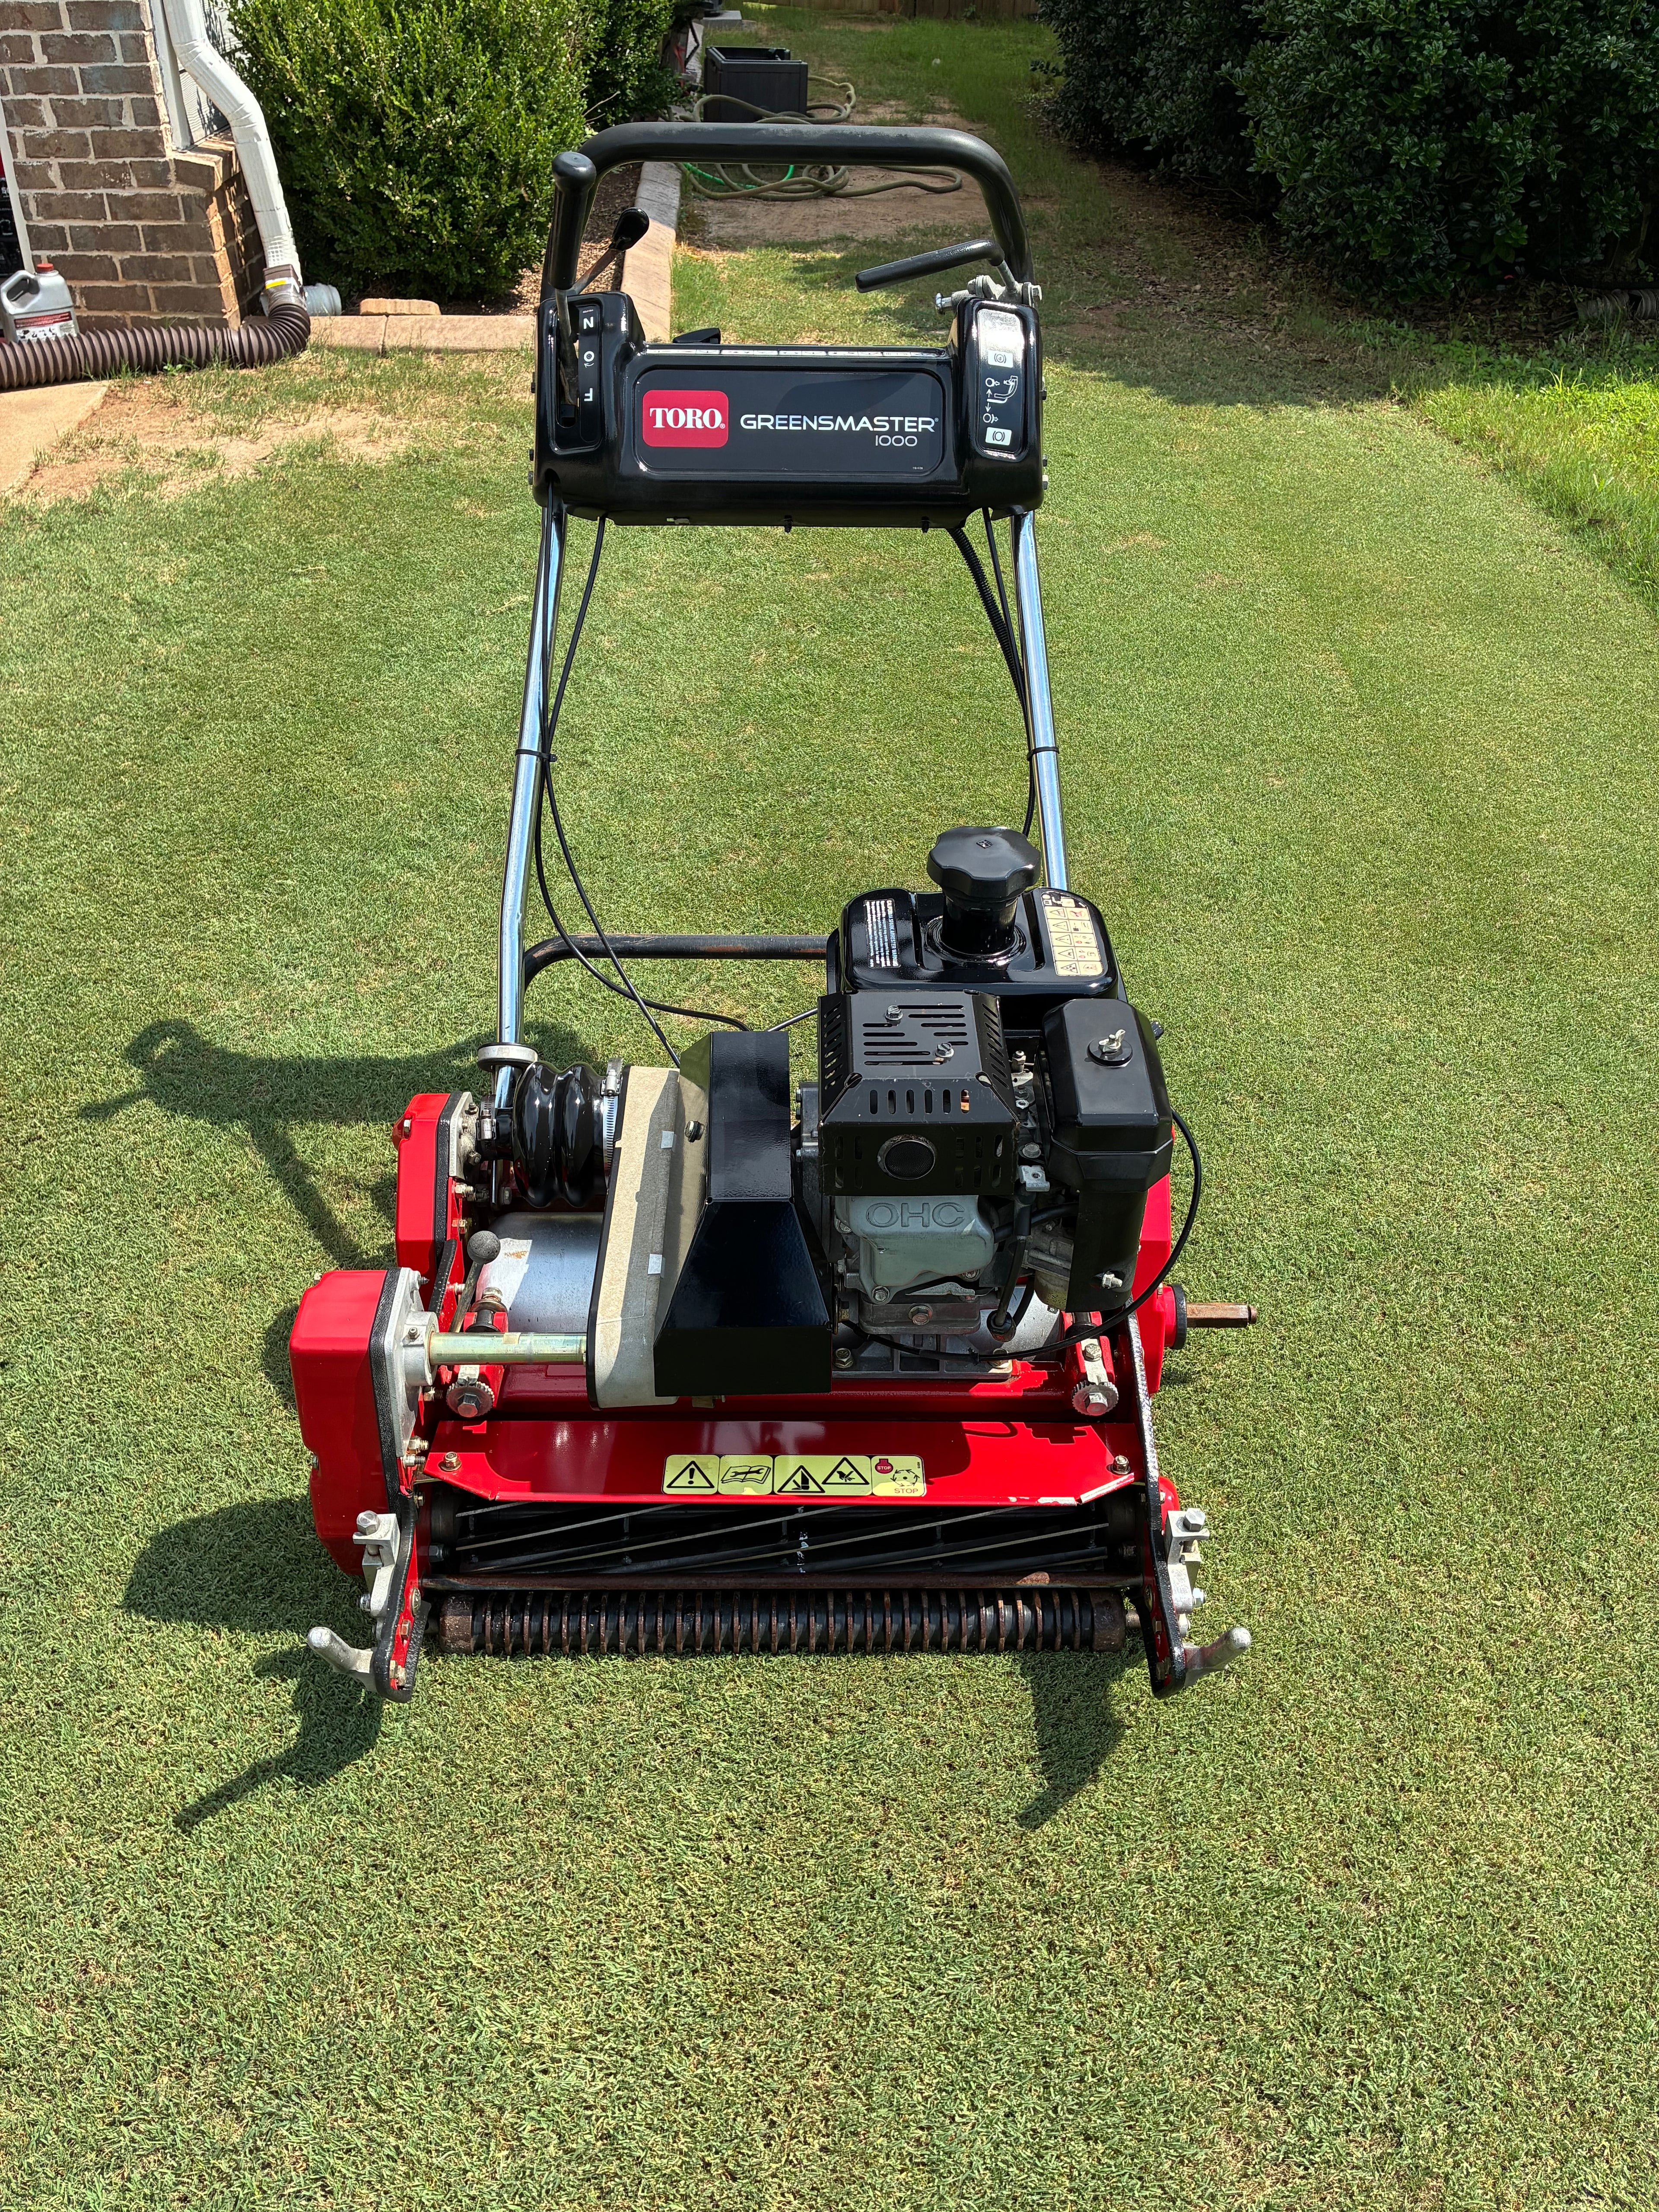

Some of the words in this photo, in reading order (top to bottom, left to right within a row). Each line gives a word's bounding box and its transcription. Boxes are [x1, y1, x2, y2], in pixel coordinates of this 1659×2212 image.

[583, 317, 594, 329] N
[649, 408, 722, 429] TORO
[740, 414, 935, 432] GREENSMASTER
[875, 435, 918, 447] 1000
[866, 1202, 965, 1228] OHC
